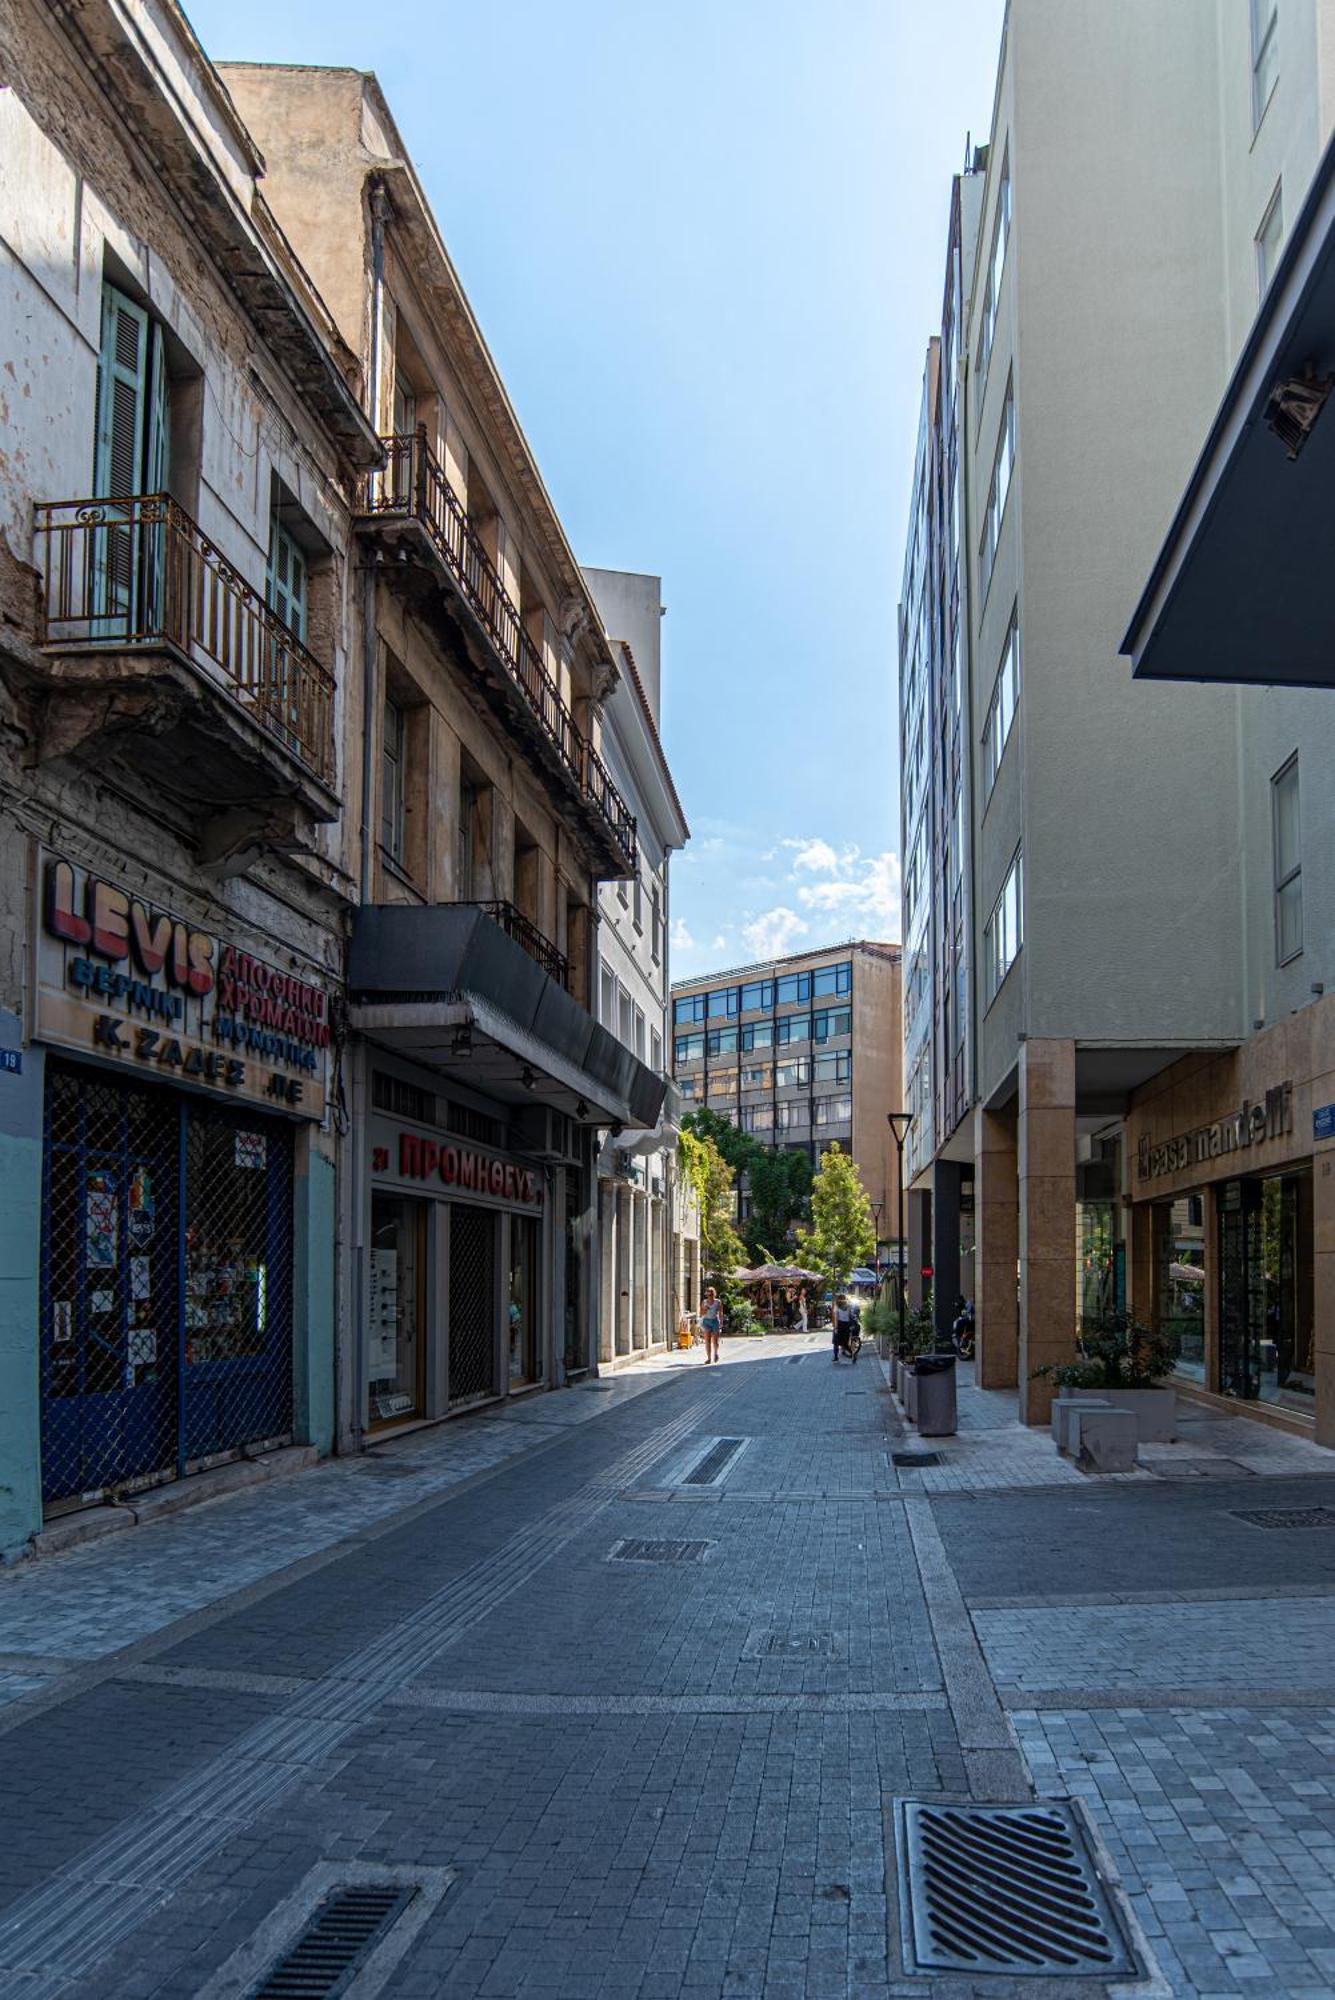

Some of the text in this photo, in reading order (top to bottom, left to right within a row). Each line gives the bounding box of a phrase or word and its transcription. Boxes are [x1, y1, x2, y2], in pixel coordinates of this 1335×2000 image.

[48, 859, 215, 996] LEVIS
[221, 947, 325, 1021] ΑΠΟΘΗΚΗ
[4, 1053, 17, 1068] 18
[1189, 1080, 1293, 1162] mandelli
[400, 1133, 536, 1202] ΠΡΟΜΗΘΕΥΣ
